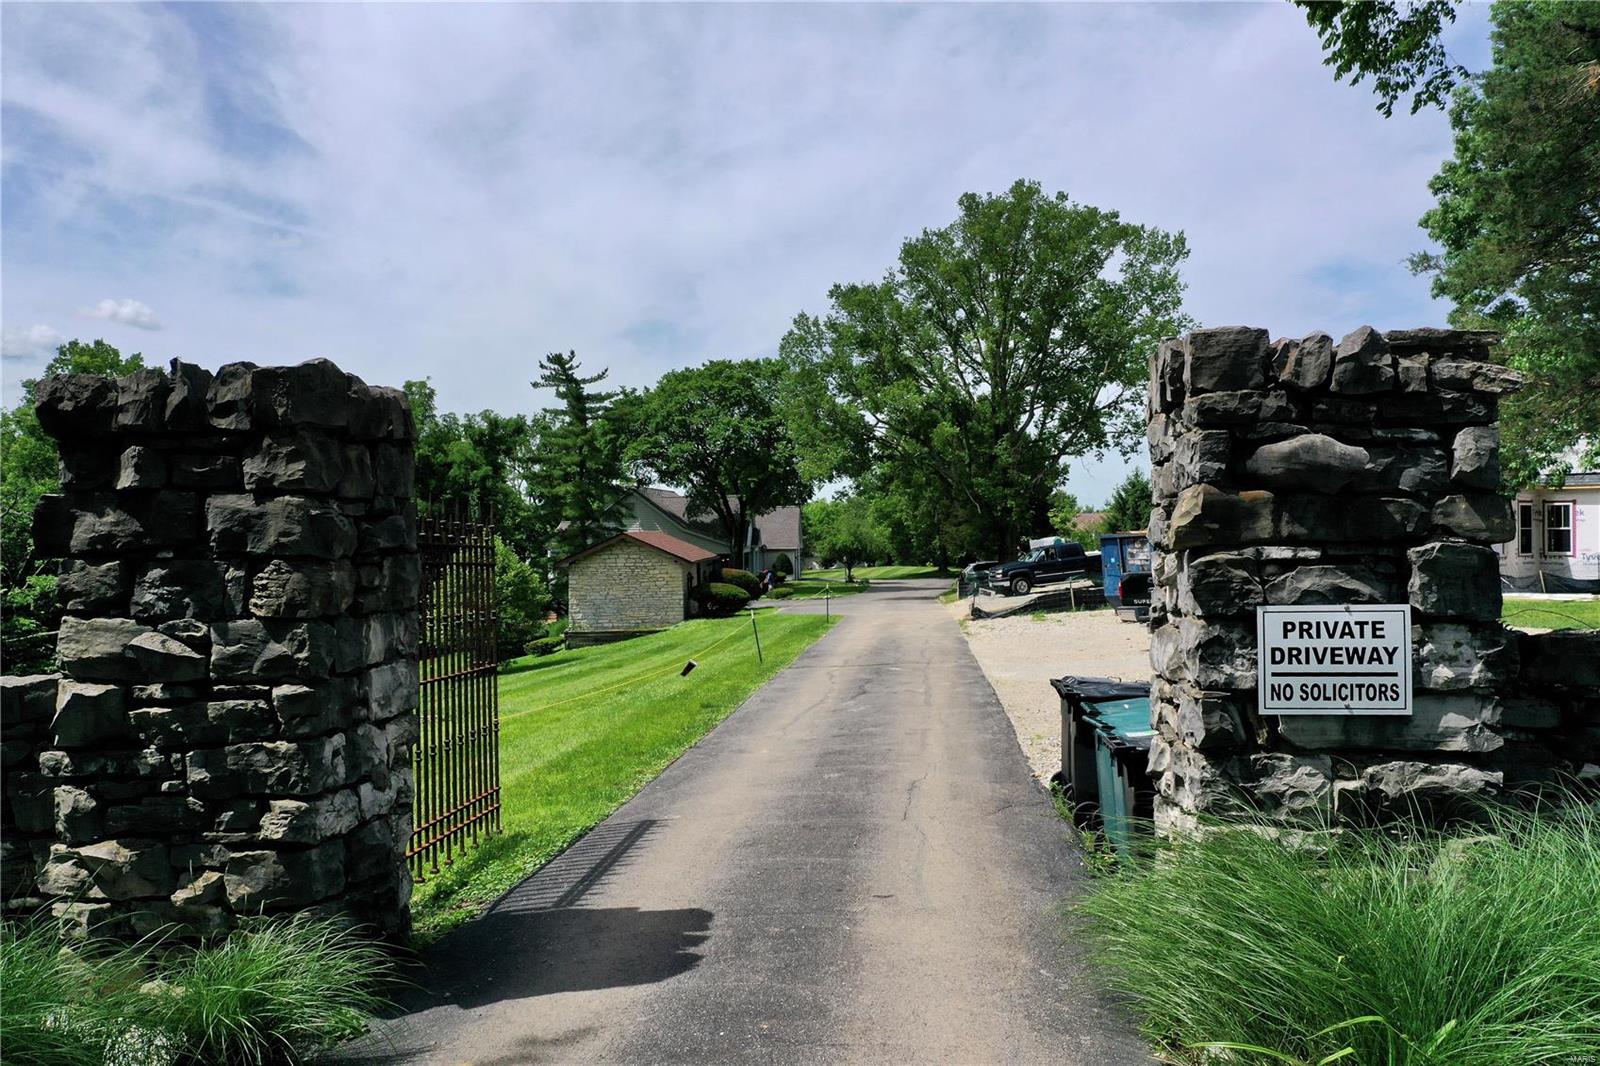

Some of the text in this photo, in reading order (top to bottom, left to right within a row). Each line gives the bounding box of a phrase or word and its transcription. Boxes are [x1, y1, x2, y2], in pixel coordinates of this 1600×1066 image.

[1282, 620, 1386, 640] PRIVATE
[1270, 646, 1399, 665] DRIVEWAY
[1270, 683, 1400, 702] NO SOLICITORS
